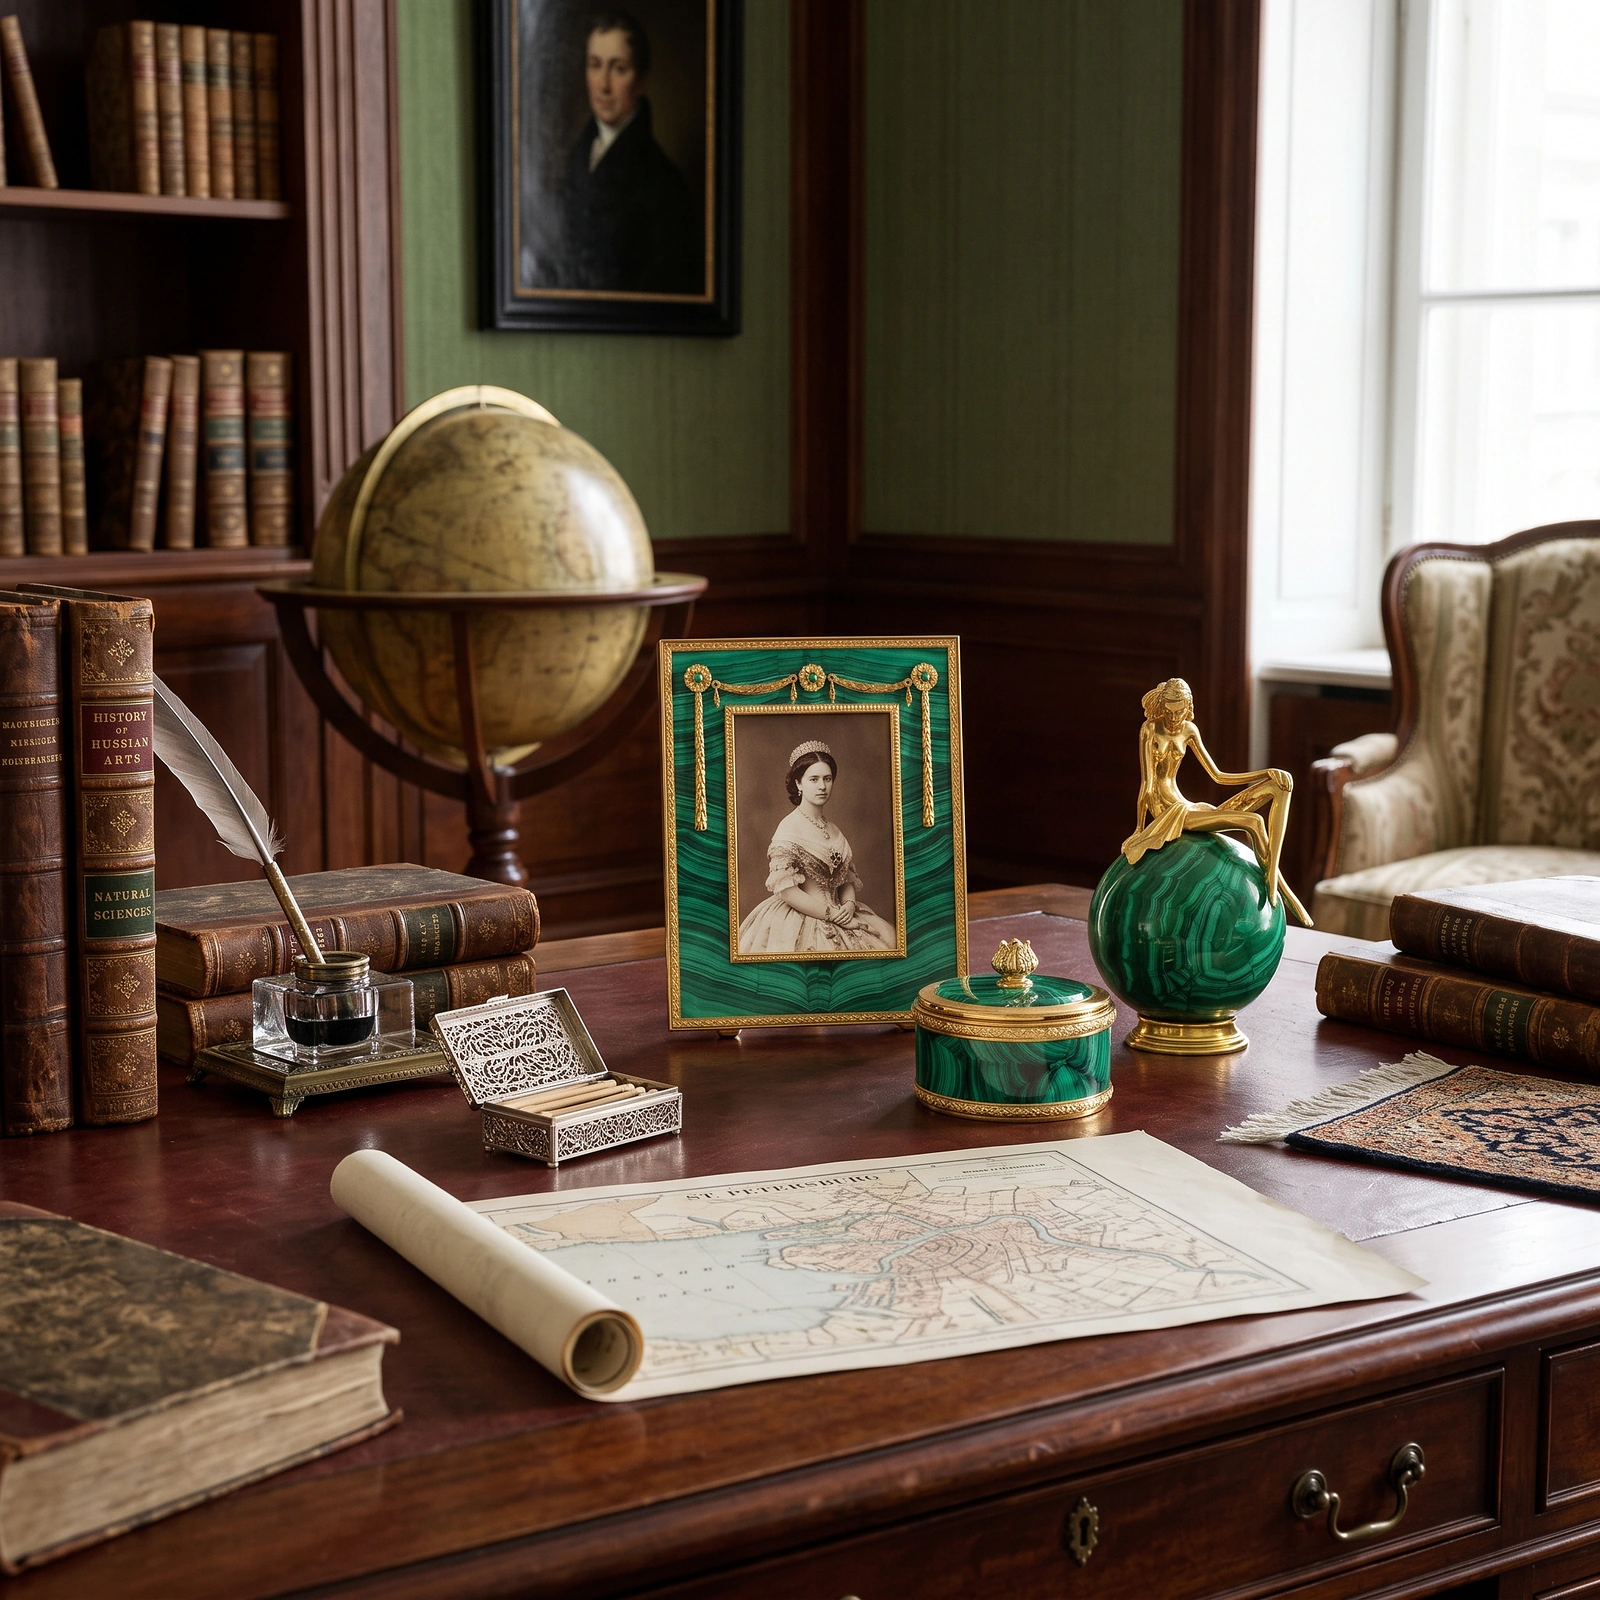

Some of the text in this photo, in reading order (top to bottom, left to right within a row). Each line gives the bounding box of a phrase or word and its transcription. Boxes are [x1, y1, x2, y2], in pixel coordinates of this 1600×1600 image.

[93, 711, 147, 723] HISTORY
[91, 737, 149, 749] HUSSIAN
[104, 754, 141, 765] ARTS
[94, 888, 151, 902] NATURAL
[94, 906, 152, 920] SCIENCES
[727, 1174, 880, 1197] PETERSBURG
